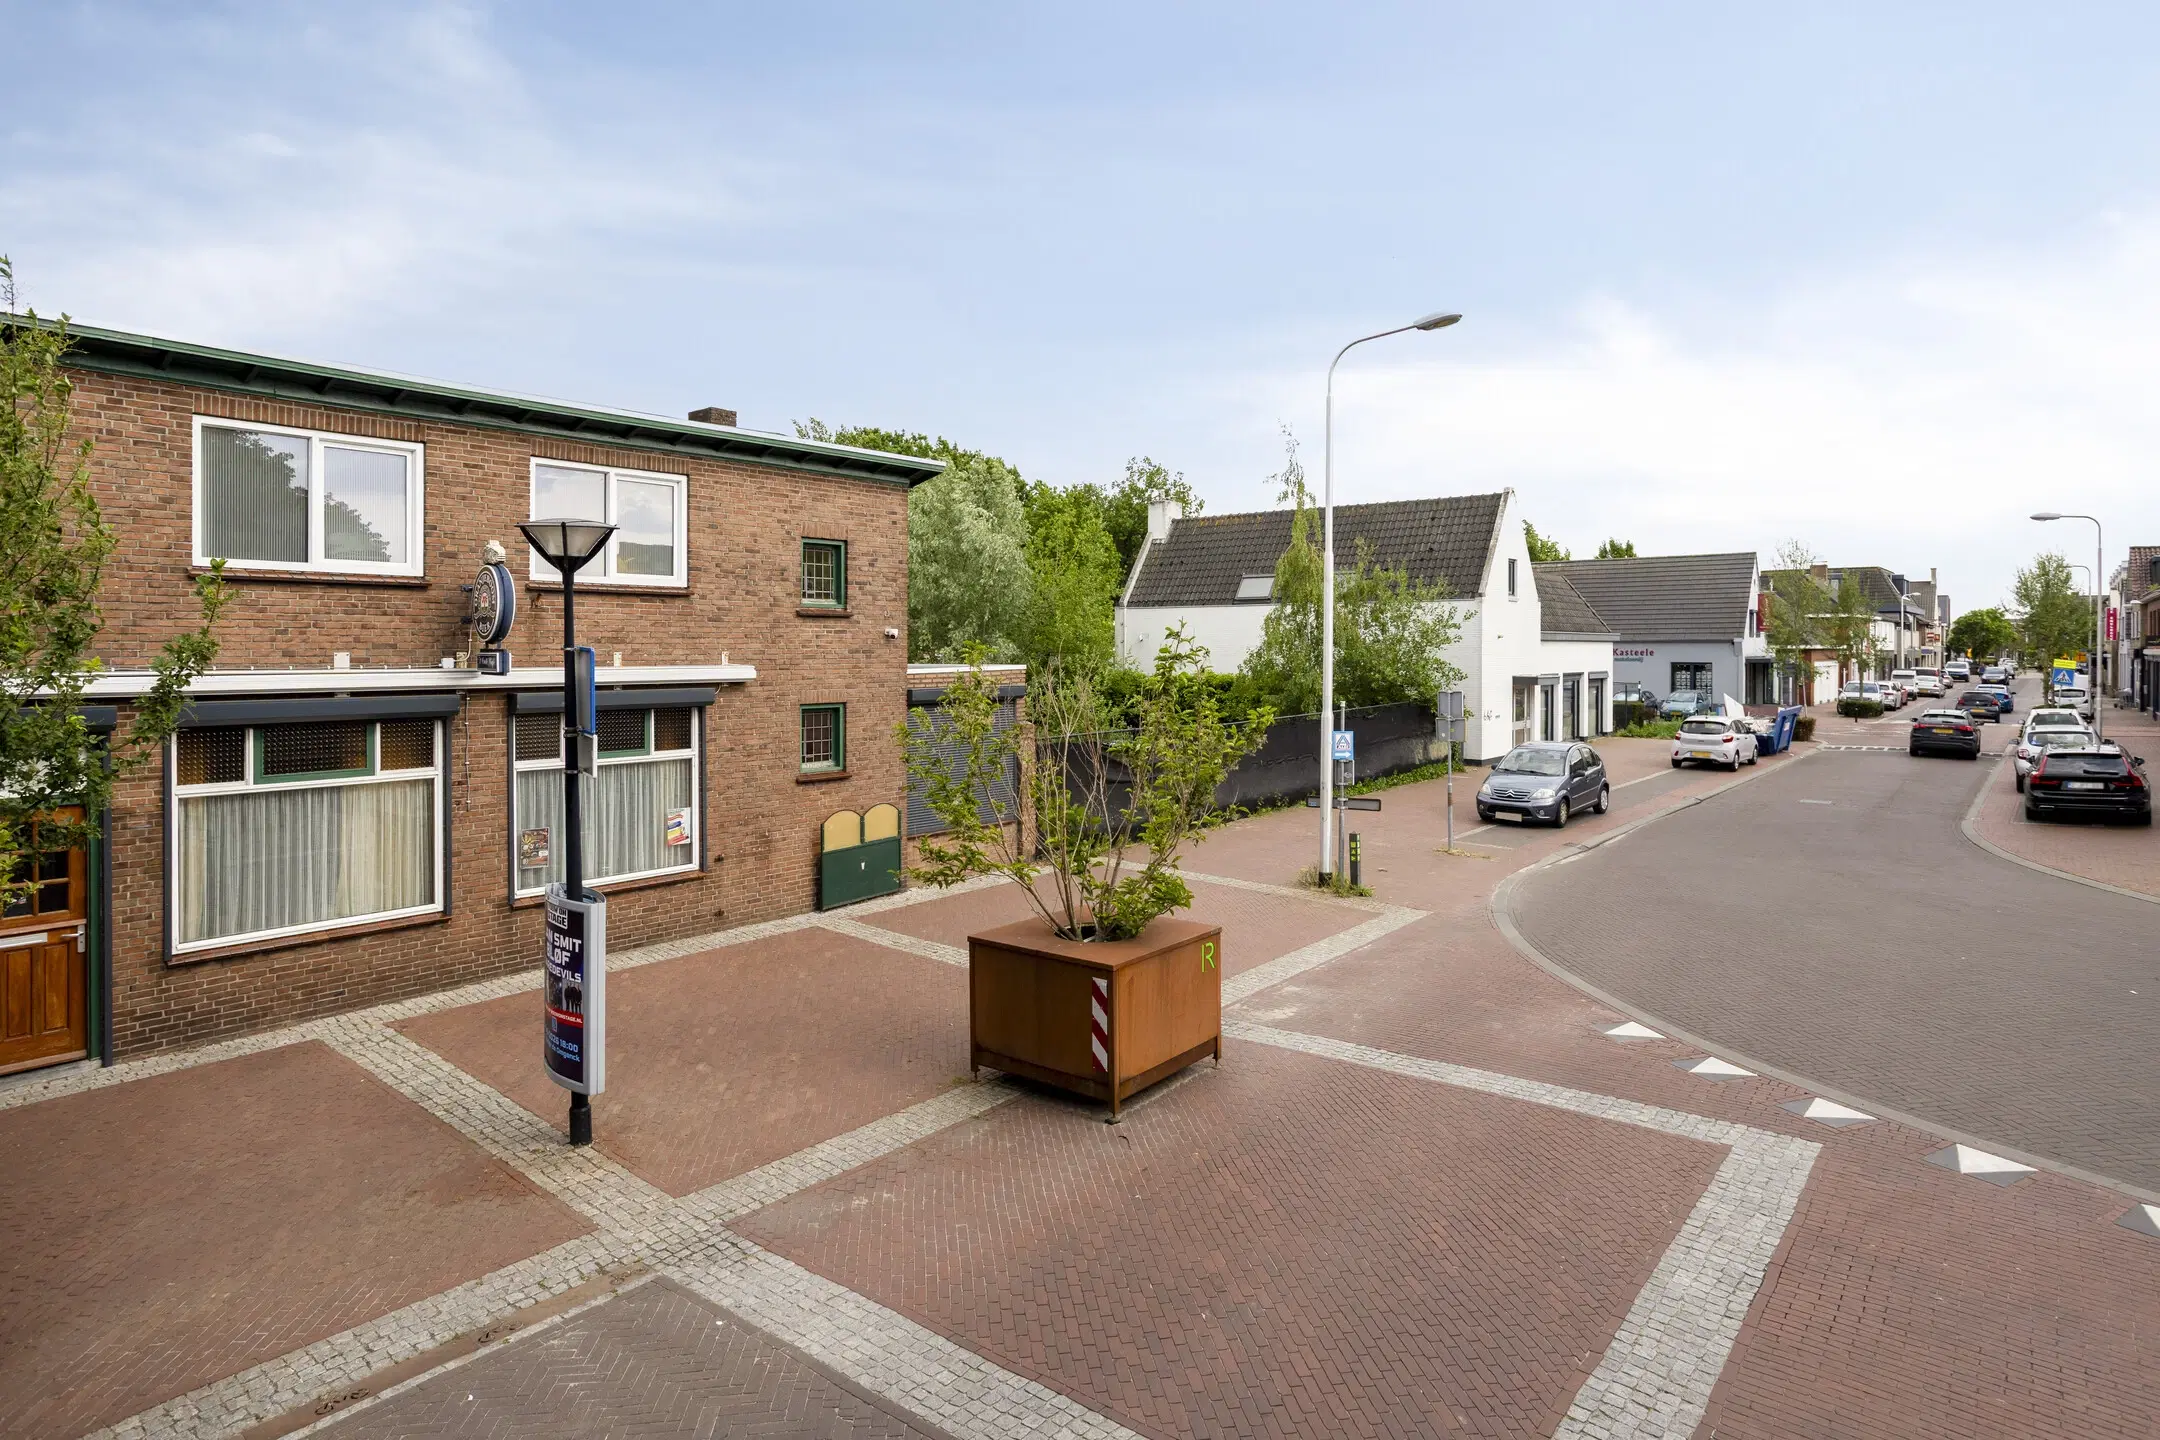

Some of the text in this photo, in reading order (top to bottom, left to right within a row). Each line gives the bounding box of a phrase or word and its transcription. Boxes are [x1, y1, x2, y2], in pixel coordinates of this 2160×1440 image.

[1613, 648, 1655, 657] Kasteele
[558, 907, 567, 917] ON
[553, 932, 582, 953] SMIT
[1201, 942, 1215, 972] R
